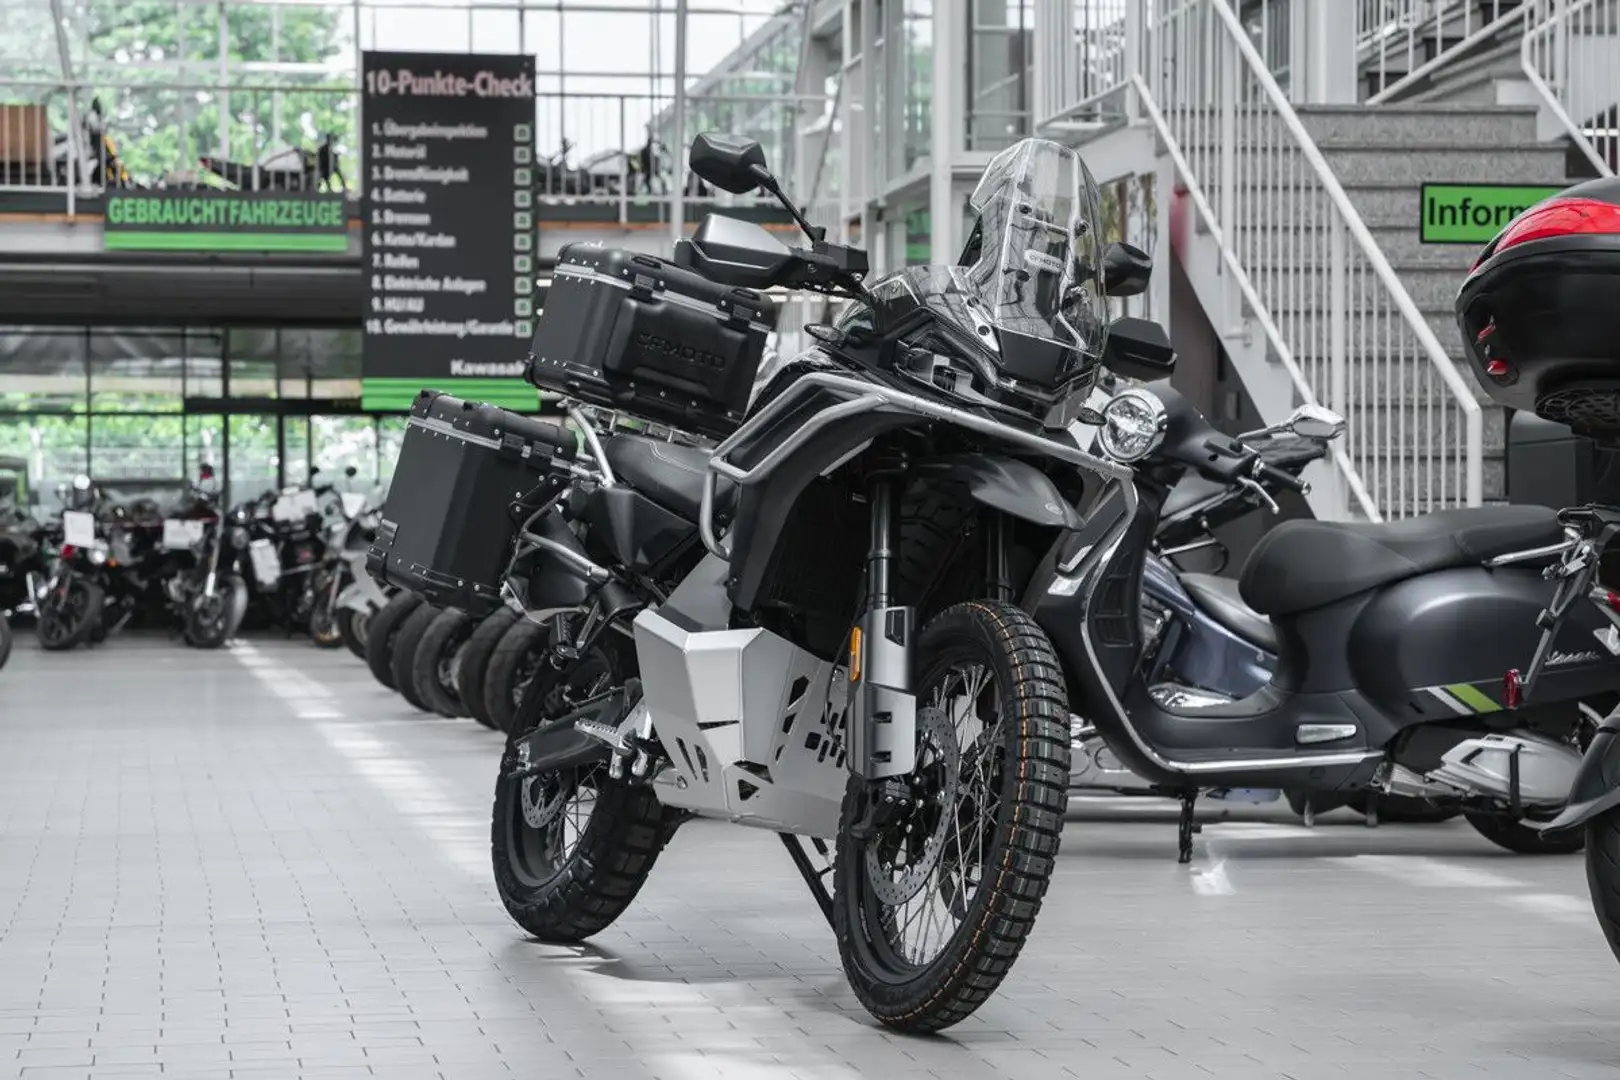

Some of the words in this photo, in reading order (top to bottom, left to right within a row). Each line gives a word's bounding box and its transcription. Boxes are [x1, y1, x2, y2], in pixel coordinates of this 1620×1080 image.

[366, 69, 534, 97] 10-Punkte-Check
[383, 187, 427, 203] Batterie
[108, 197, 343, 225] GEBRAUCHTFAHRZEUGE
[383, 208, 431, 226] Bremsen
[383, 252, 420, 269] Reifen
[450, 359, 525, 376] Kawasak
